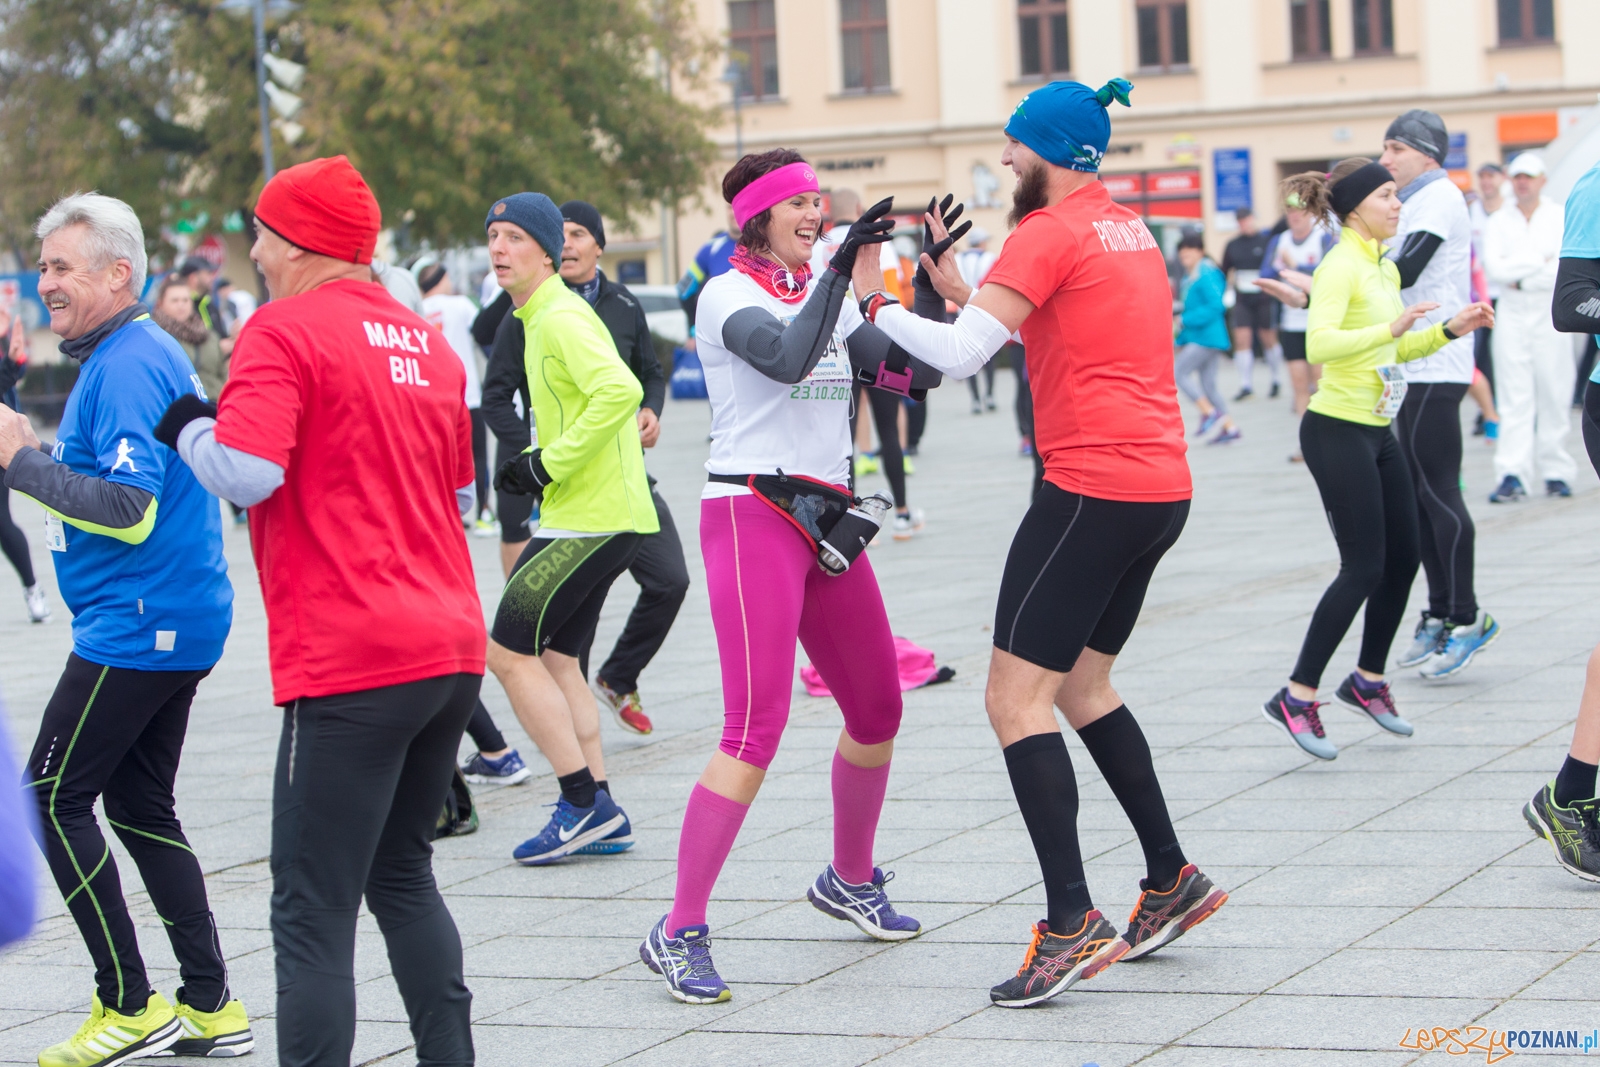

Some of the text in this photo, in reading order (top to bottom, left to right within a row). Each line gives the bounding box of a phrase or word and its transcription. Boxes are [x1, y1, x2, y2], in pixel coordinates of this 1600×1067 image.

[362, 320, 430, 355] MAŁY
[389, 355, 430, 387] BIL
[524, 537, 585, 591] CRAFT
